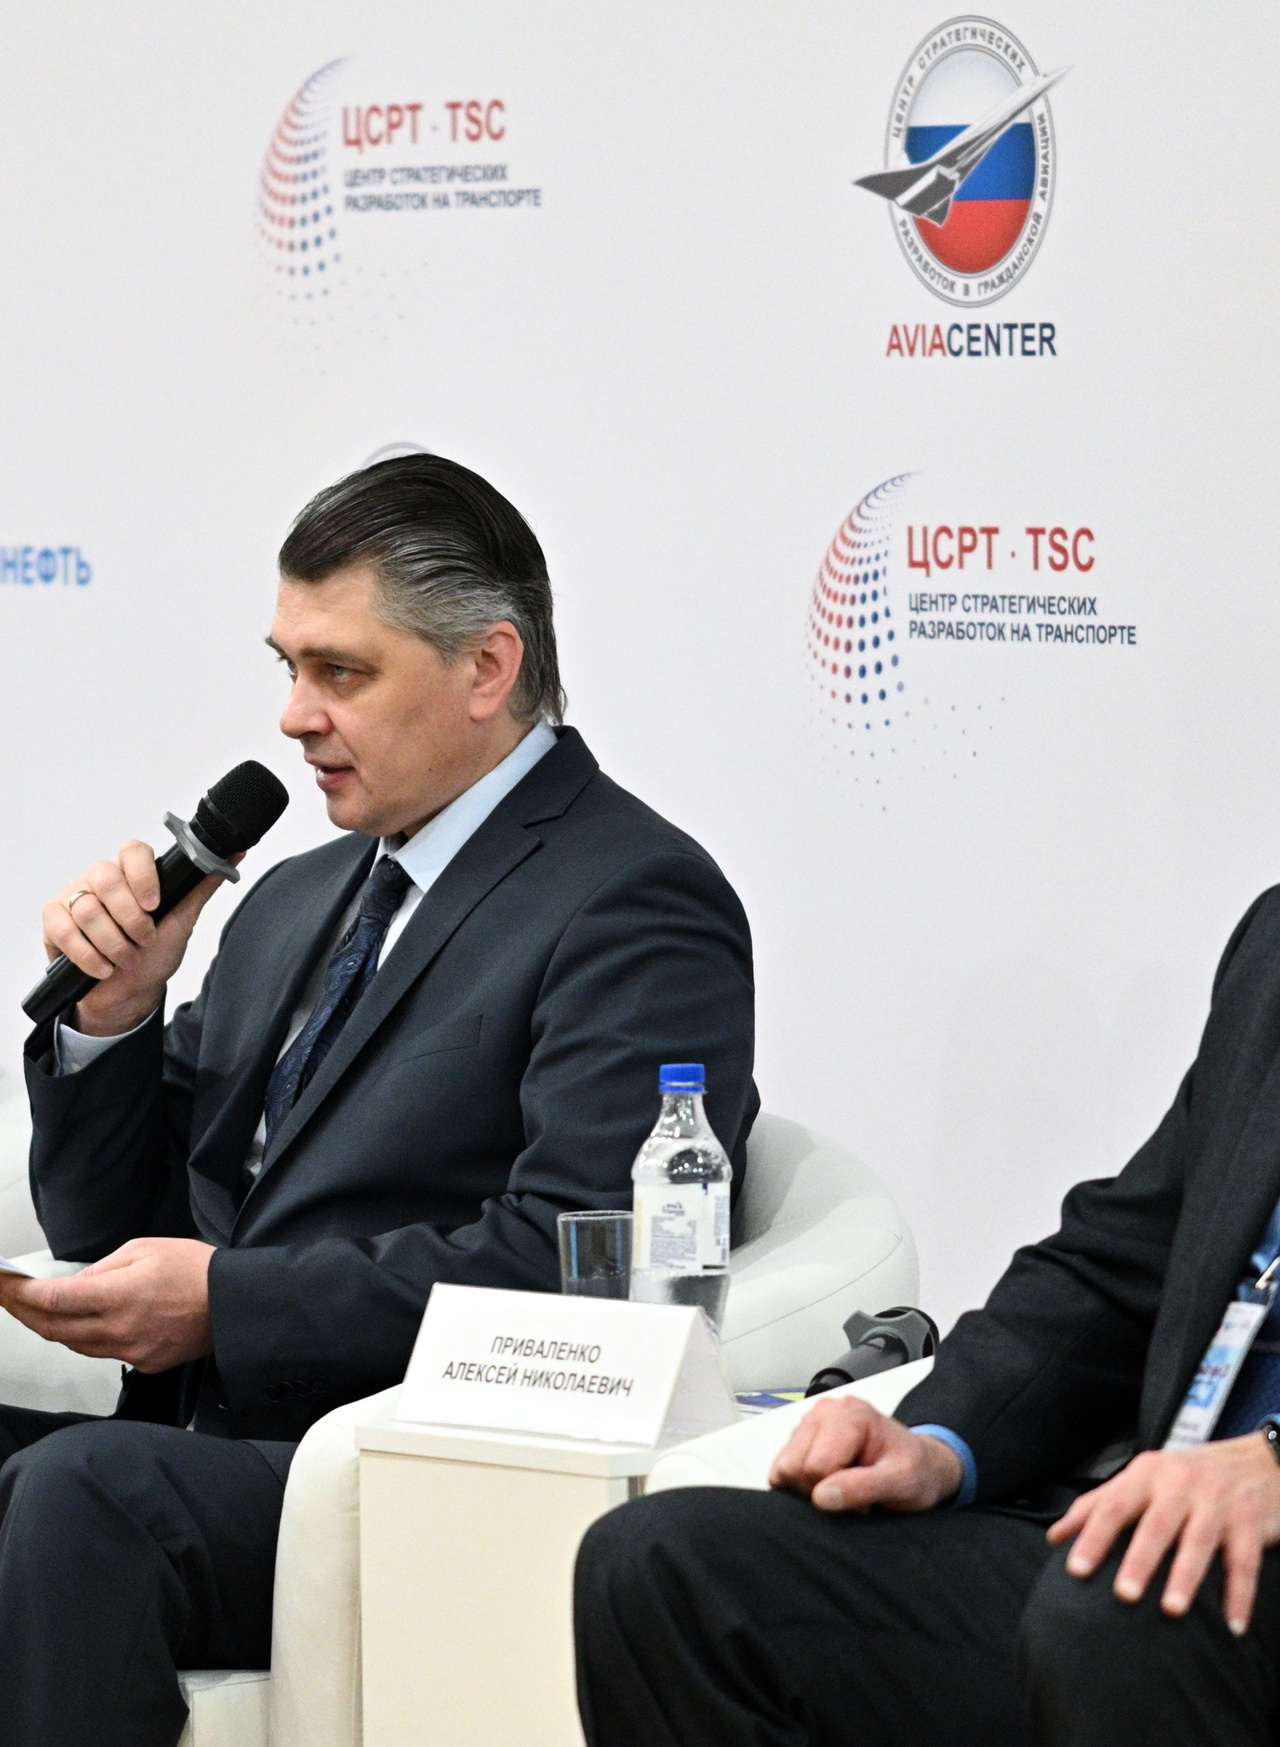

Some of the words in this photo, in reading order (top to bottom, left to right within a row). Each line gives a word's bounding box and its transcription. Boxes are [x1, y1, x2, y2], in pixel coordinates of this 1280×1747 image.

[893, 75, 915, 138] ЦЕНТР
[918, 26, 1026, 73] СТРАТЕГИЧЕСКИХ
[342, 103, 423, 154] ЦСРТ
[446, 99, 506, 143] TSC
[345, 168, 385, 188] ЦЕНТР
[391, 164, 508, 186] СТРАТЕГИЧЕСКИХ
[345, 193, 428, 212] РАЗРАБОТОК
[433, 192, 450, 210] НА
[455, 188, 542, 209] ТРАНСПОРТЕ
[899, 218, 956, 294] РАЗРАБОТОК
[977, 211, 1043, 296] ГРАЖДАНСКОЙ
[1037, 113, 1050, 202] АВИАЦИИ
[886, 323, 1058, 357] AVIACENTER
[907, 526, 999, 577] ЦСРТ
[1025, 527, 1095, 572] TSC
[909, 593, 957, 614] ЦЕНТР
[962, 594, 1097, 616] СТРАТЕГИЧЕСКИХ
[909, 621, 1006, 642] РАЗРАБОТОК
[1010, 622, 1032, 642] НА
[1036, 624, 1137, 645] ТРАНСПОРТЕ
[490, 1336, 601, 1363] ПРИВАЛЕНКО
[442, 1361, 518, 1385] АЛЕКСЕЙ
[521, 1368, 634, 1398] НИКОЛАЕВИЧ
